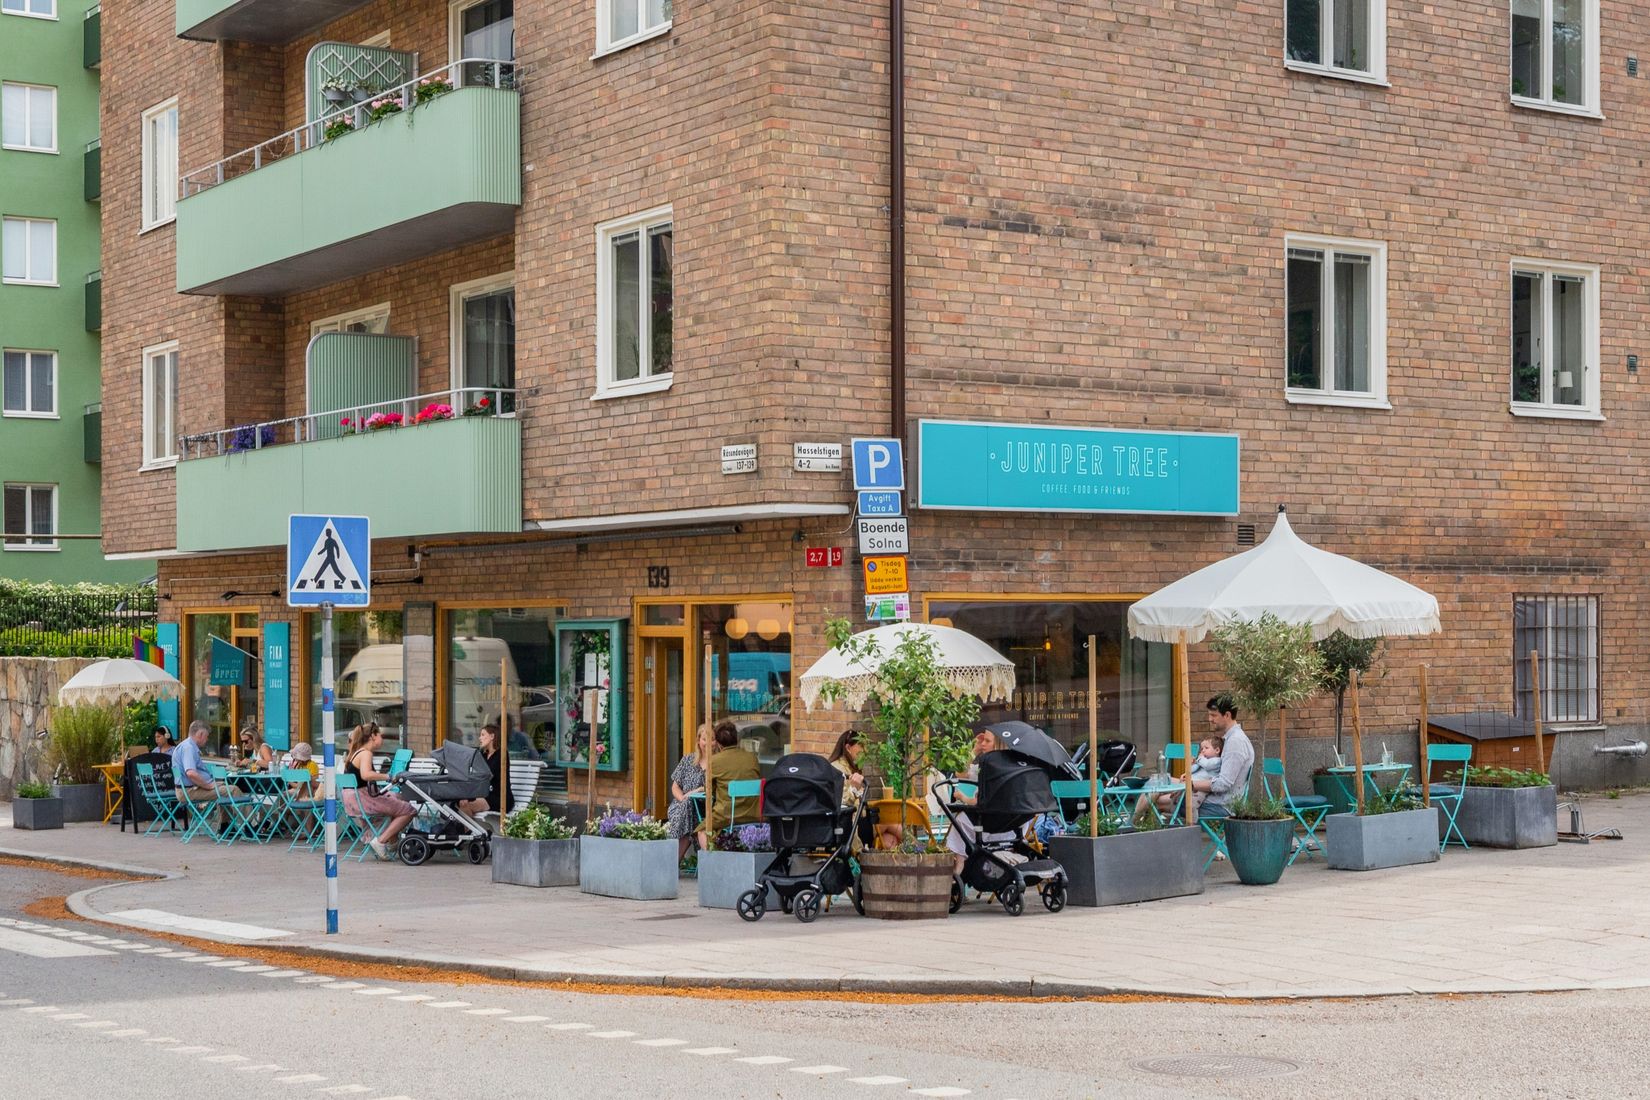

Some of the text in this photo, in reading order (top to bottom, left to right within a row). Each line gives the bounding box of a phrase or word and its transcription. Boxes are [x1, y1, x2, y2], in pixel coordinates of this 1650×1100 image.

[797, 446, 840, 458] Hasselstigen
[736, 460, 755, 470] 137-139
[798, 459, 811, 469] 4-2
[868, 444, 891, 484] P
[1001, 441, 1169, 478] JUNIPER TREE
[1073, 484, 1091, 494] FOOD
[1100, 485, 1131, 496] FRIENDS
[868, 494, 891, 503] Avgift
[860, 522, 905, 533] Boende
[868, 538, 902, 549] Solna
[810, 552, 823, 563] 2,7
[644, 566, 669, 588] 139
[269, 645, 282, 660] FIKA
[215, 667, 241, 678] ÖPPET
